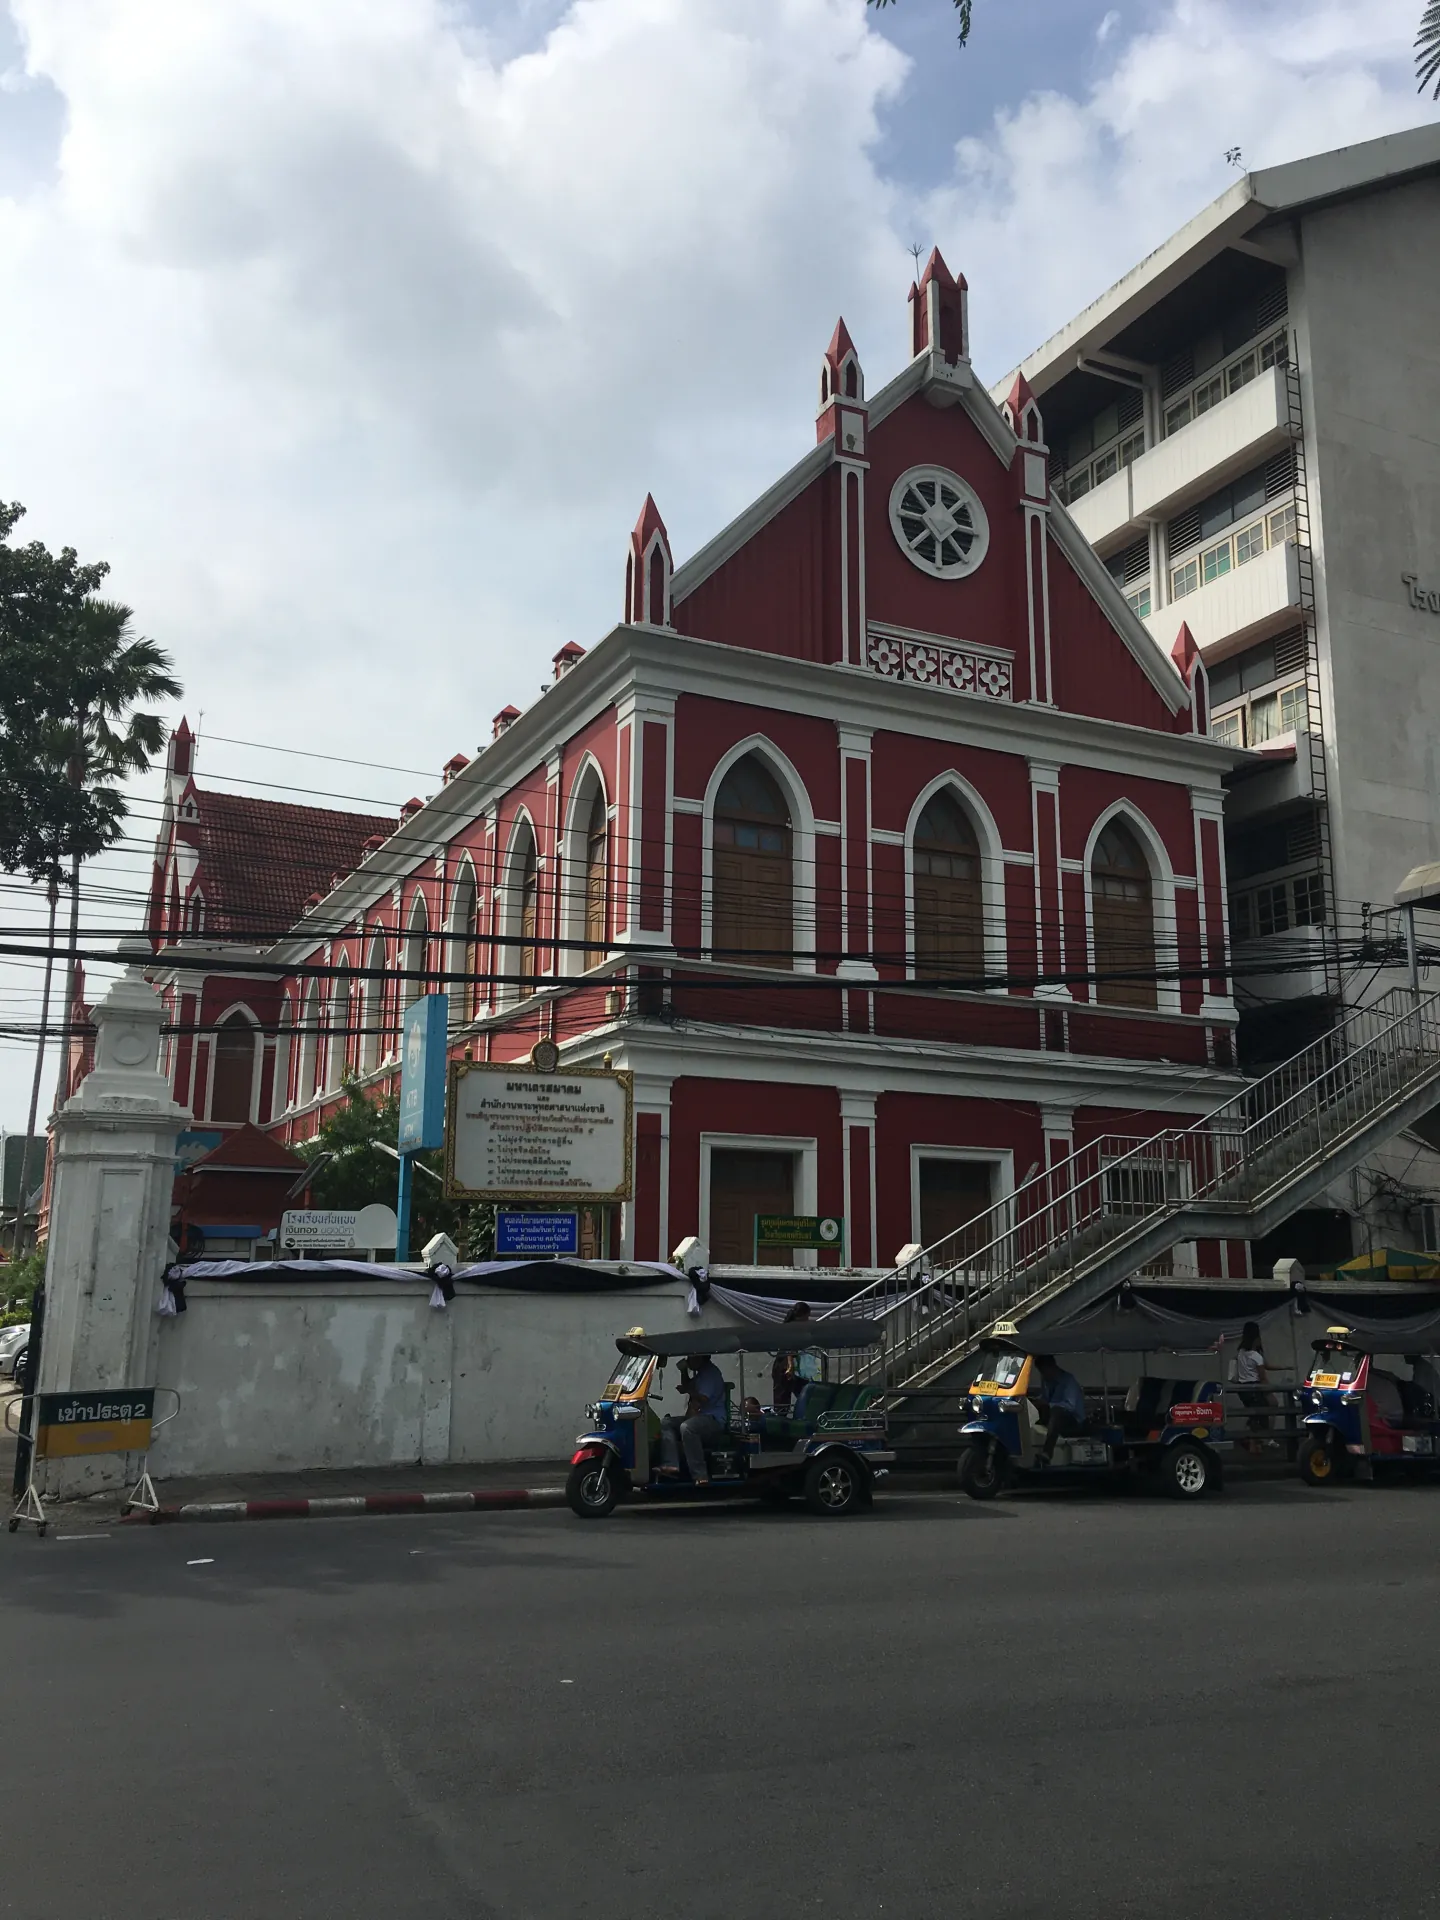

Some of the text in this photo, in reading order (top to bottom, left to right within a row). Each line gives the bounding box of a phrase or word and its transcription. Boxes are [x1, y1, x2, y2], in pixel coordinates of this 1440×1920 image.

[506, 1081, 582, 1095] มหาเถรสมาคม
[480, 1099, 605, 1114] สำนักงานพระพุทธศาสนาแห่งชาติ
[286, 1212, 356, 1225] โรงเรียนต้นแบบ
[285, 1225, 318, 1234] เงินทอง
[57, 1400, 146, 1425] เข้าประตู 2
